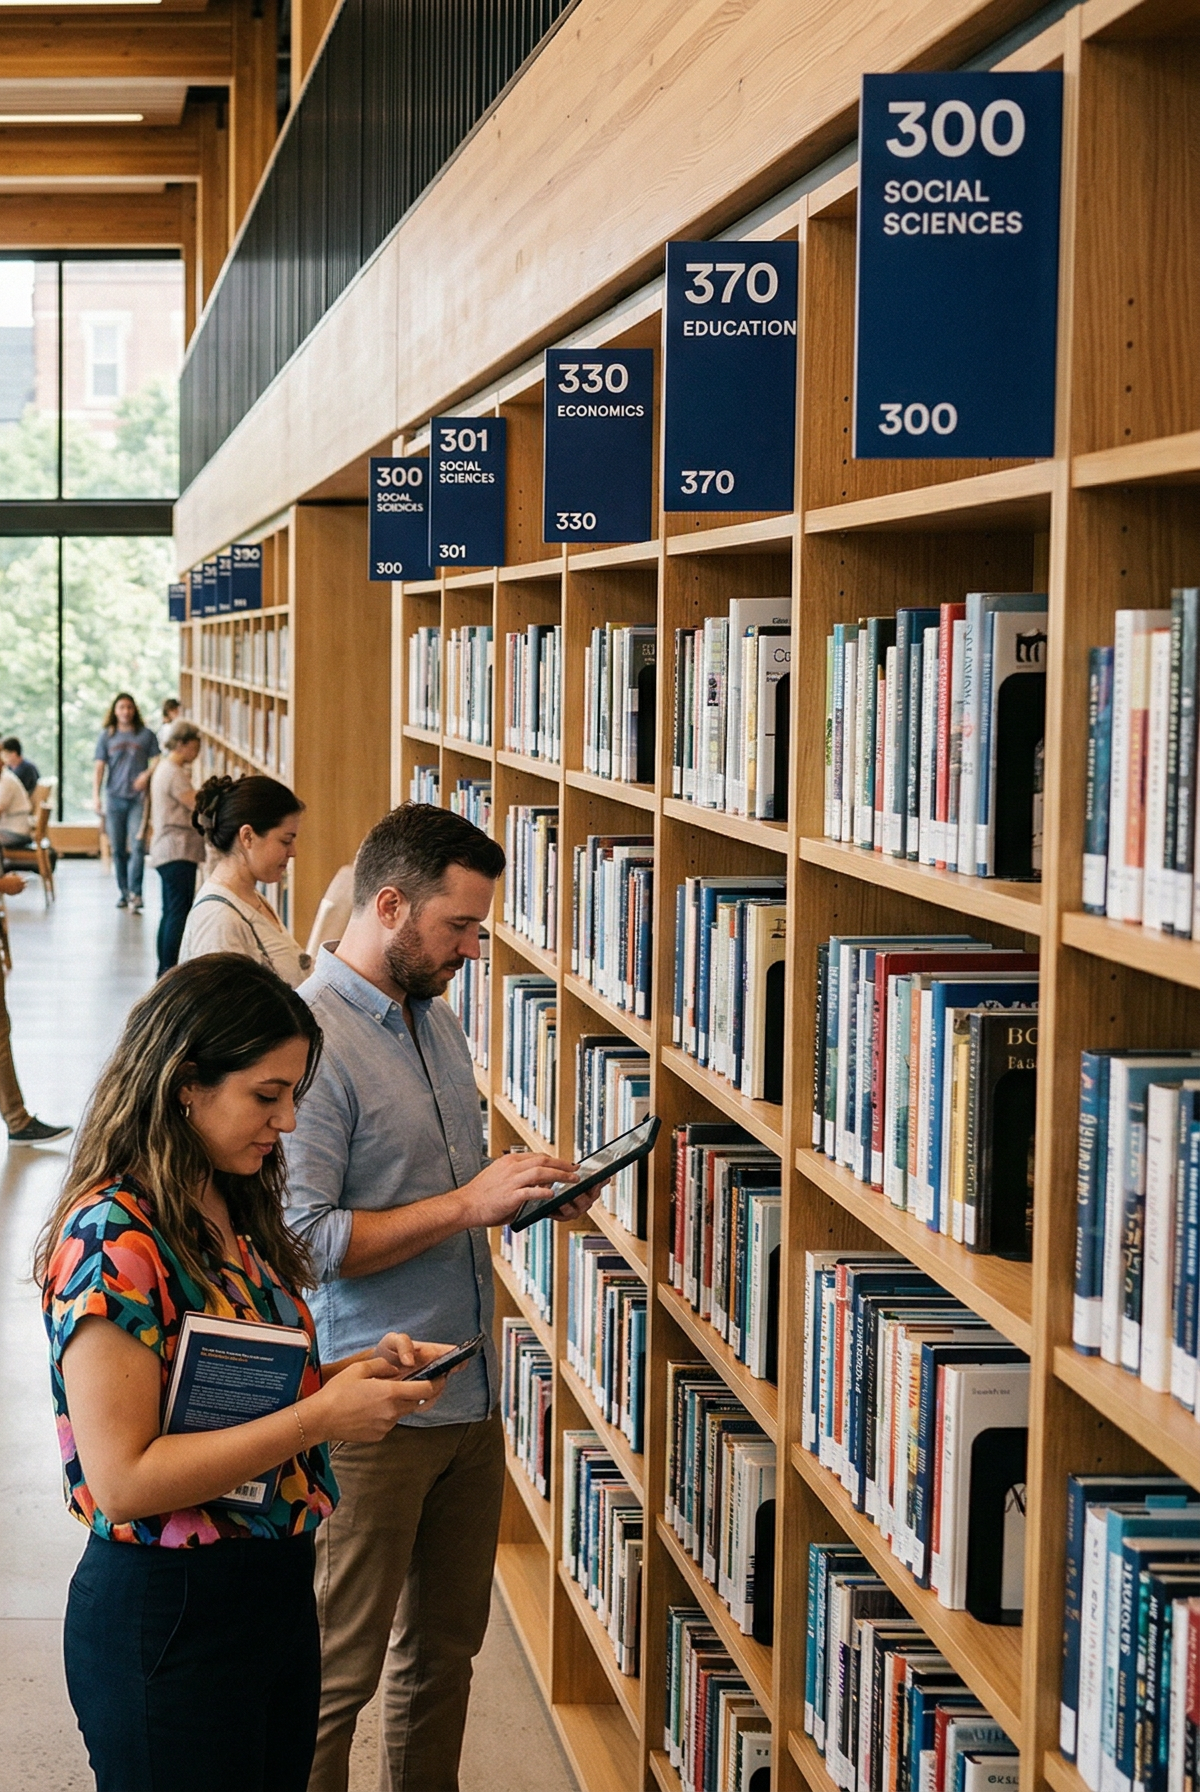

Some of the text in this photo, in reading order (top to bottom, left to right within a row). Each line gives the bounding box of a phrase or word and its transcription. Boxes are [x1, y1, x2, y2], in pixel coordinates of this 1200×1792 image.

[885, 99, 1026, 158] 300
[883, 179, 990, 204] SOCIAL
[883, 211, 1023, 235] SCIENCES
[684, 262, 779, 305] 370
[683, 319, 797, 337] EDUCATION
[558, 363, 629, 394] 330
[557, 405, 645, 417] ECONOMICS
[878, 402, 958, 436] 300
[439, 428, 488, 452] 301
[376, 466, 423, 487] 300
[439, 461, 482, 471] SOCIAL
[439, 473, 495, 483] SCIENCES
[680, 469, 735, 495] 370
[555, 512, 597, 530] 330
[439, 544, 466, 558] 301
[376, 562, 403, 575] 300
